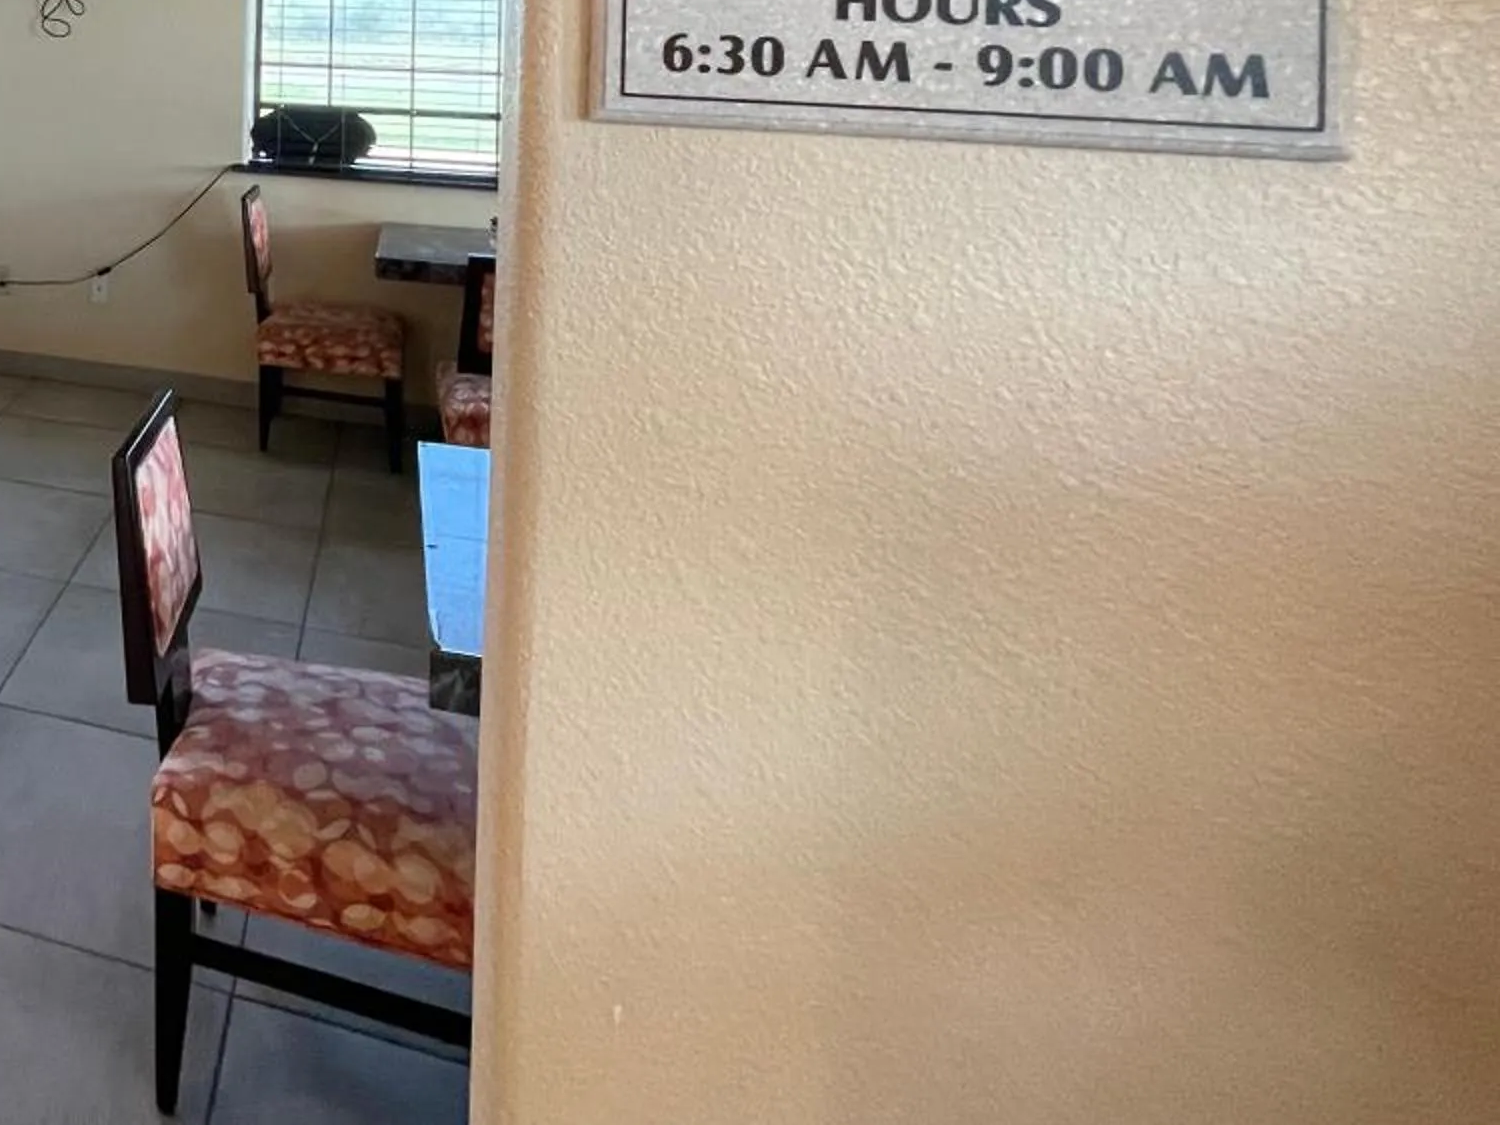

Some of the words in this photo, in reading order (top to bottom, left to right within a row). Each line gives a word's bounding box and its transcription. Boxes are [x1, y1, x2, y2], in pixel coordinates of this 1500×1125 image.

[662, 32, 785, 77] 6:30
[806, 38, 911, 83] AM
[933, 62, 954, 72] -
[977, 44, 1124, 92] 9:00
[1148, 51, 1269, 99] AM
